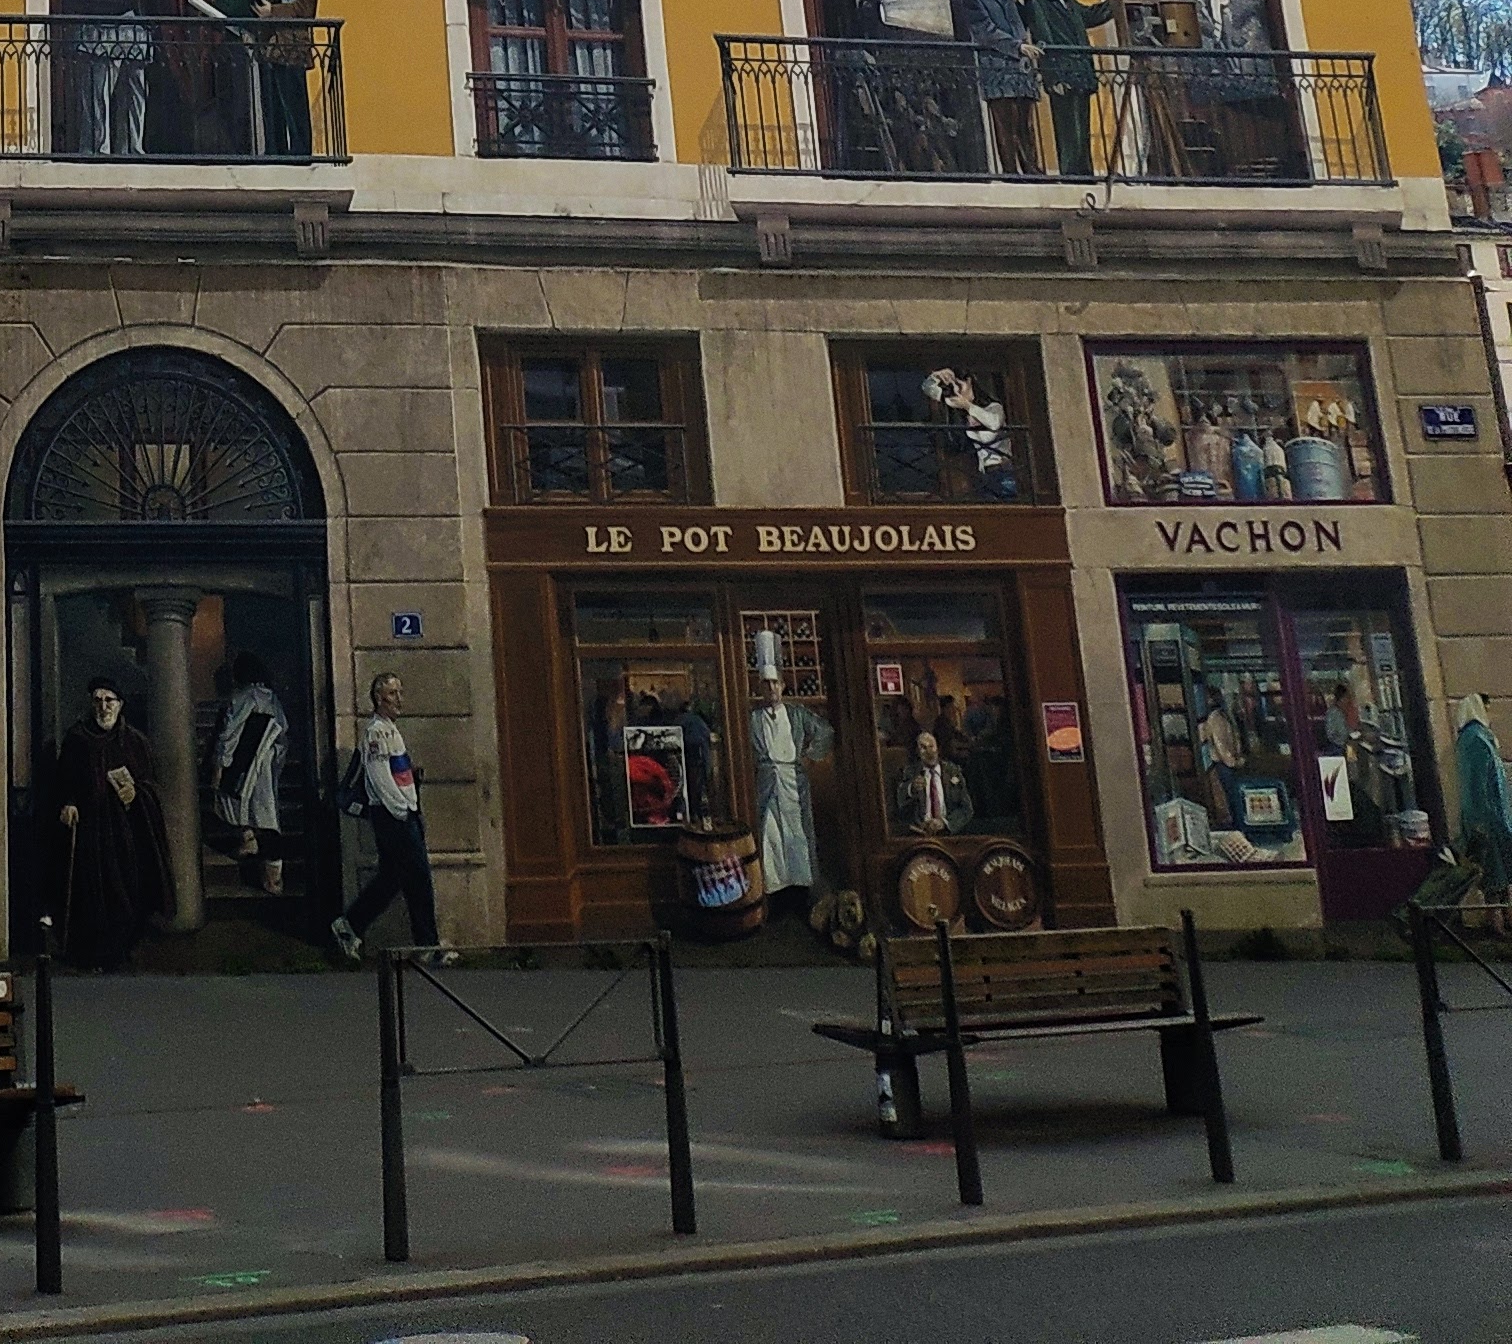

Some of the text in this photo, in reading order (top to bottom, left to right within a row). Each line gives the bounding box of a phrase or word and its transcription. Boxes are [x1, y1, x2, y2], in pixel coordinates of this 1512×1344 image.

[586, 525, 978, 553] LE POT BEAUJOLAIS
[1155, 520, 1344, 554] VACHON
[401, 616, 412, 634] 2
